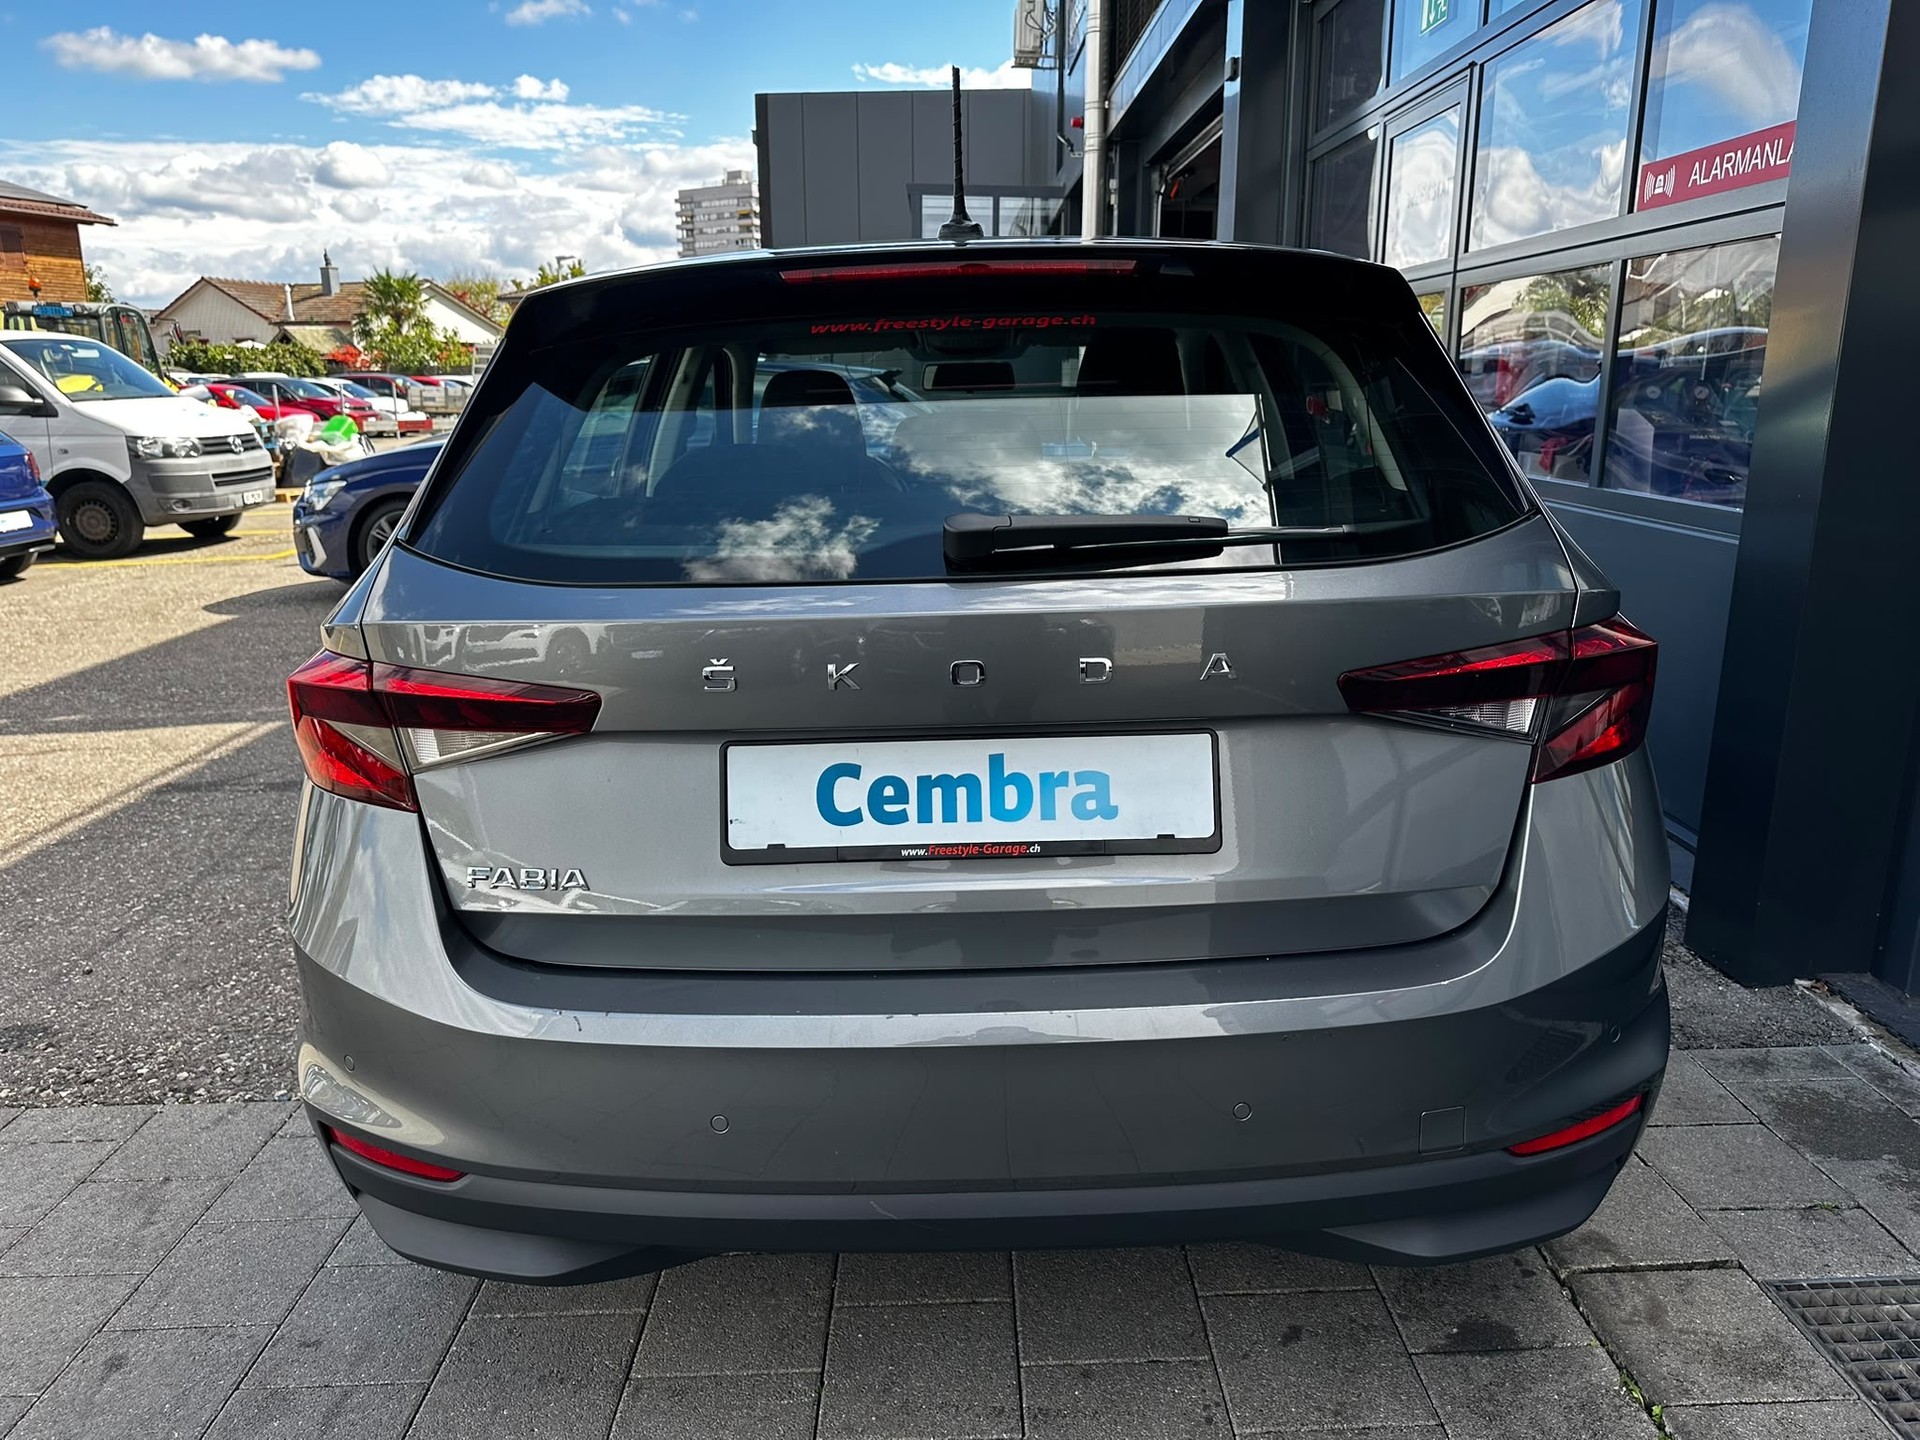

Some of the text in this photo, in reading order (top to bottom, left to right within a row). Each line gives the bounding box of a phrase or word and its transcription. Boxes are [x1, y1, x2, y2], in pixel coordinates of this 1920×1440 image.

[810, 314, 1096, 334] www.freestyle-garage.ch
[702, 653, 1237, 692] ŠKODA
[815, 753, 1118, 826] Cembra
[901, 843, 1040, 857] www.Freestyle-Garage.ch
[466, 866, 590, 891] FABIA
